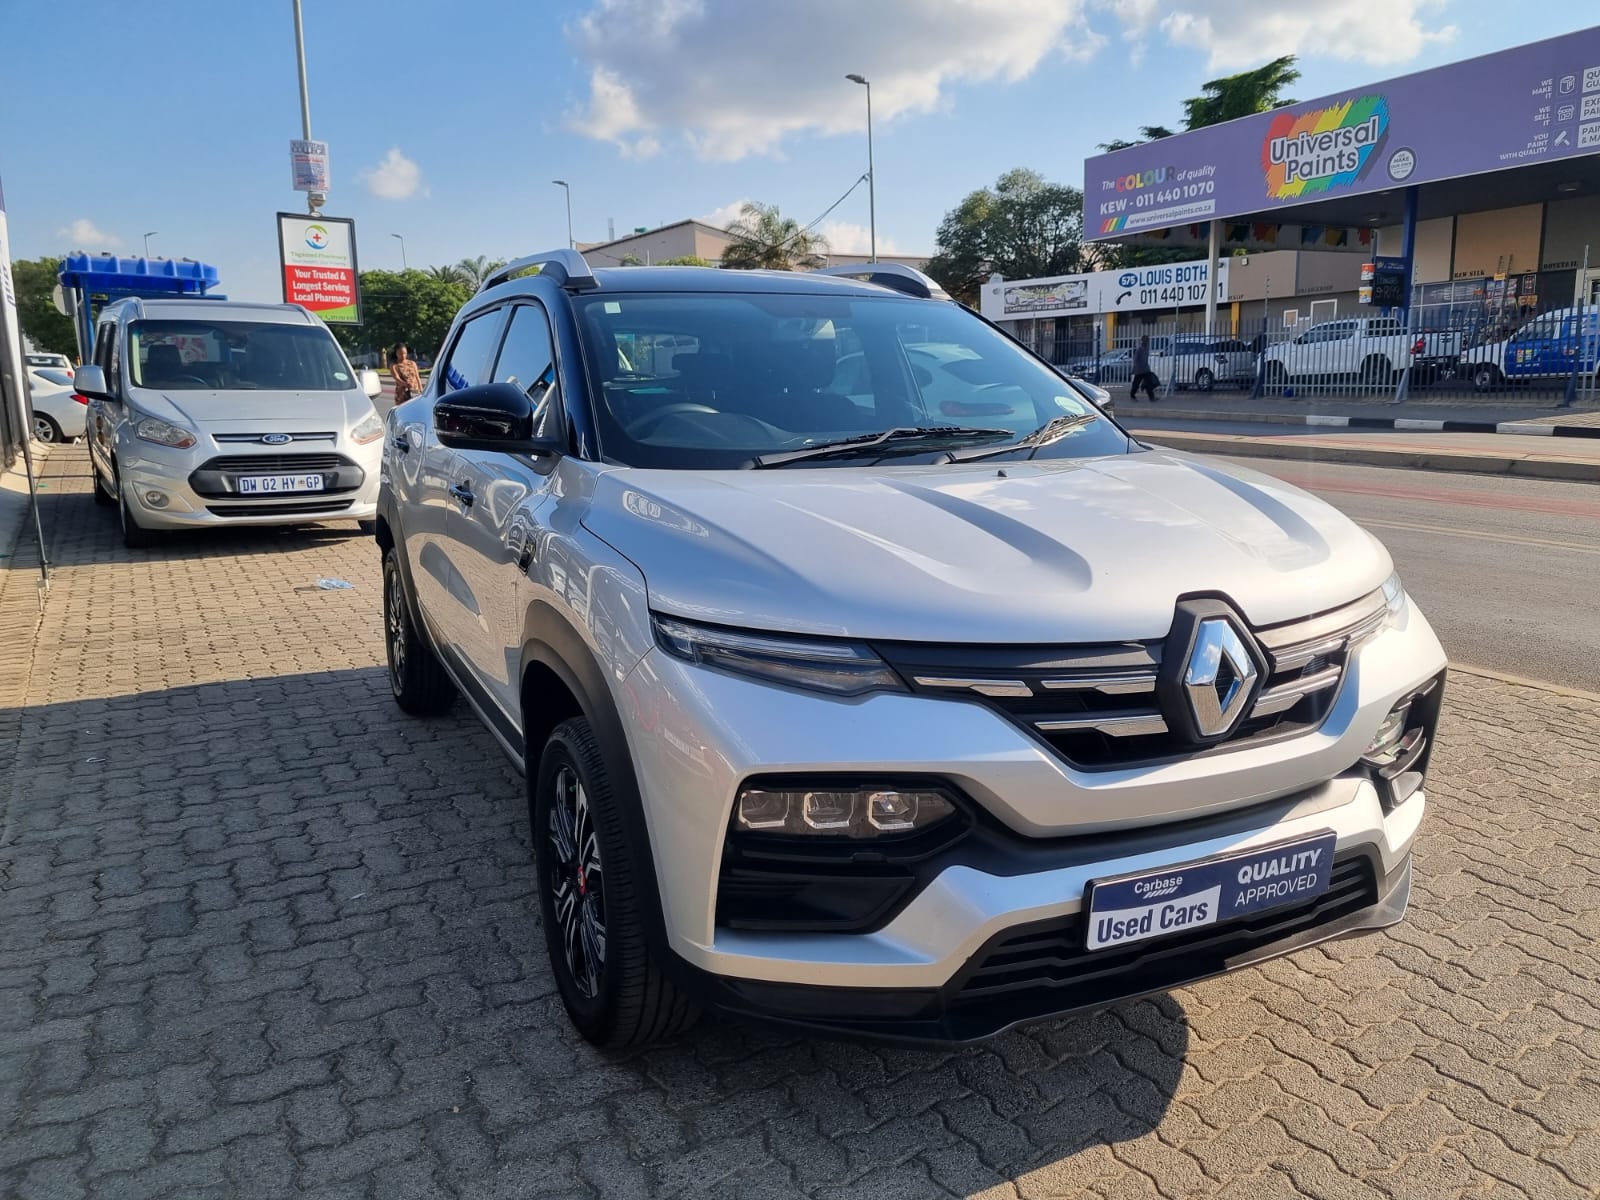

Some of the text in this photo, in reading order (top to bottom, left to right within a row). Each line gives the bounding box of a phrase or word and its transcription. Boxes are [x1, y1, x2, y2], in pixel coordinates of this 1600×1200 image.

[1541, 78, 1553, 87] WE
[1586, 79, 1600, 88] GU
[1532, 86, 1553, 95] MAKE
[1539, 106, 1551, 114] WE
[1534, 113, 1551, 122] SELL
[1271, 118, 1378, 163] Universal
[1534, 132, 1549, 141] YOU
[1527, 139, 1549, 149] PAINT
[1500, 147, 1548, 160] WITH QUALITY
[1287, 150, 1357, 181] Paints
[1102, 164, 1216, 193] The COLOUR of quality
[1100, 198, 1128, 216] KEW
[1135, 192, 1154, 208] 011
[1156, 187, 1181, 204] 440
[1184, 180, 1215, 198] 1070
[294, 268, 347, 280] Your Trusted &
[1139, 268, 1172, 287] LOUIS
[1175, 264, 1208, 283] BOTH
[292, 280, 350, 294] Longest Serving
[293, 292, 351, 305] Local Pharmacy
[1140, 289, 1158, 304] 011
[1160, 287, 1184, 303] 440
[242, 476, 320, 492] DW 02 HY GP
[1237, 848, 1322, 884] QUALITY
[1134, 873, 1318, 908] Carbase APPROVED
[1097, 900, 1209, 943] Used Cars
